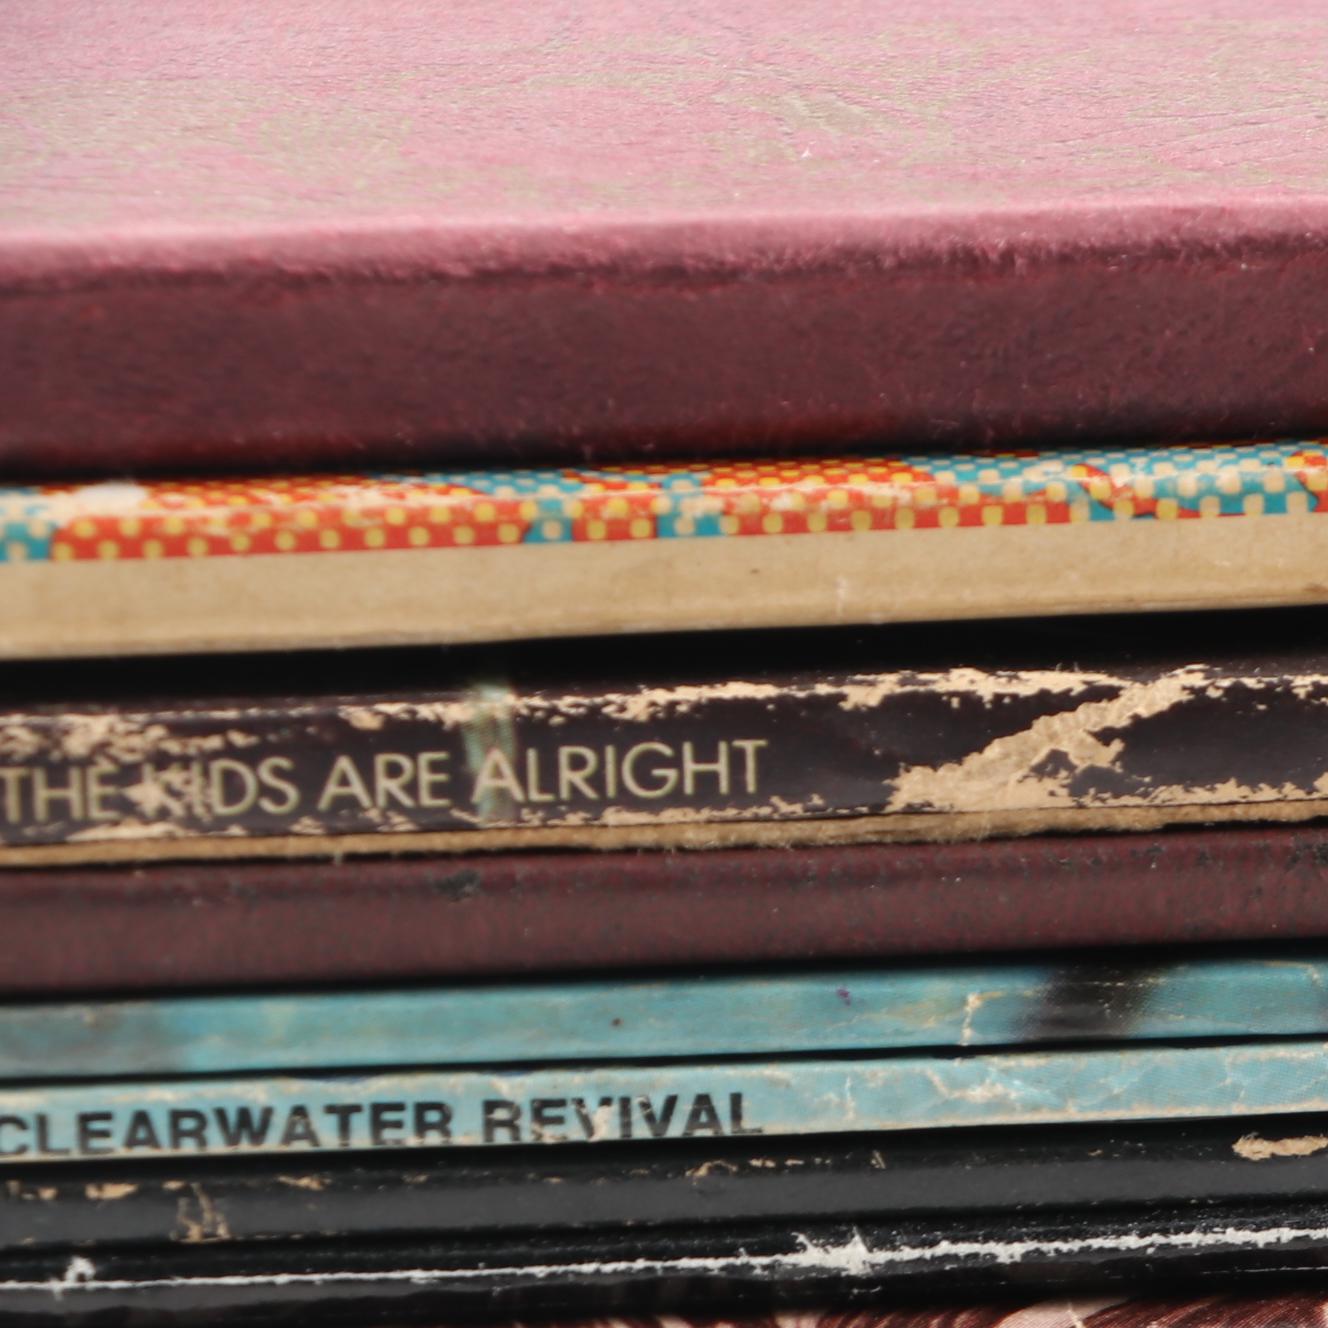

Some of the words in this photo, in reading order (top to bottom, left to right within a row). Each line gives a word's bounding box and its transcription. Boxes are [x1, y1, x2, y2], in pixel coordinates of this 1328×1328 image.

[0, 766, 122, 824] THE
[316, 752, 450, 810] ARE
[472, 739, 767, 803] ALRIGHT
[0, 1099, 453, 1155] CLEARWATER
[483, 1092, 764, 1144] REVIVAL
